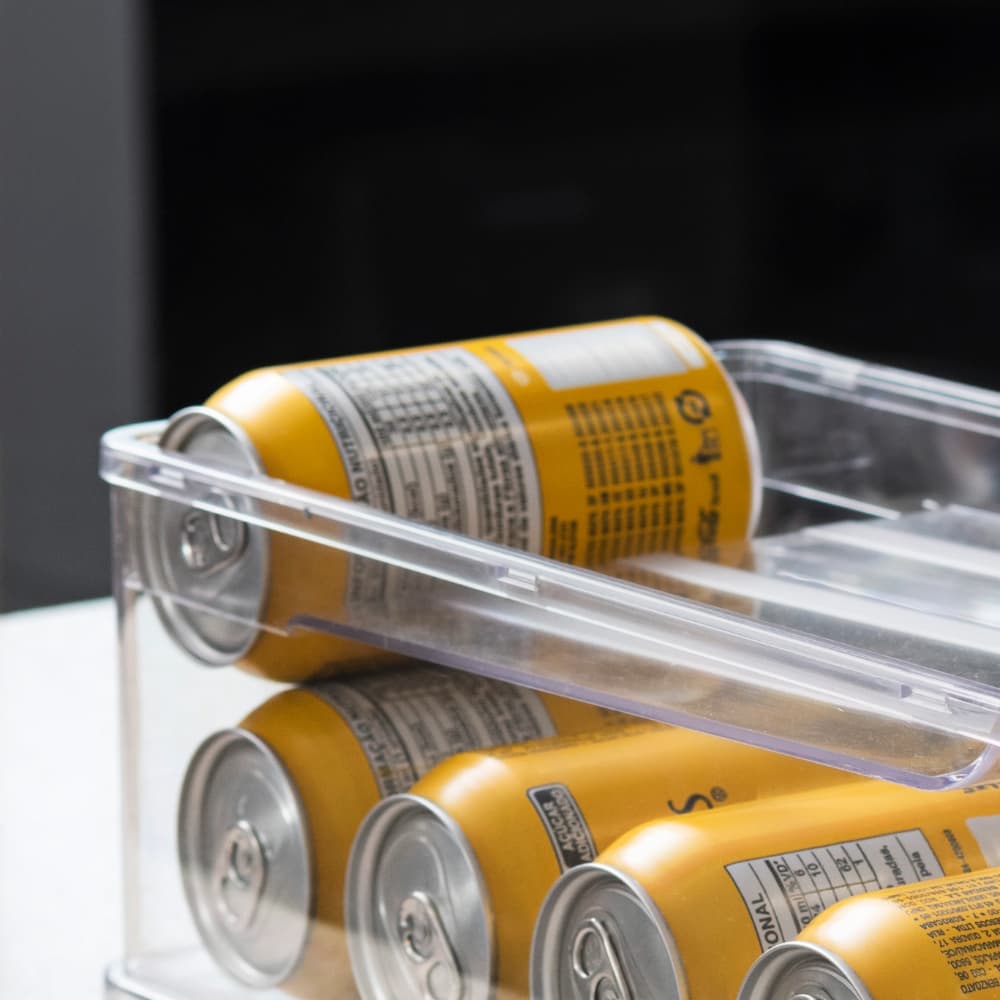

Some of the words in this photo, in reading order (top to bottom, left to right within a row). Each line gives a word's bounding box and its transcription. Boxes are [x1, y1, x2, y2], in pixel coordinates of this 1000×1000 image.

[807, 863, 823, 876] 10
[910, 851, 932, 877] pela
[959, 977, 1000, 994] BENZOATO
